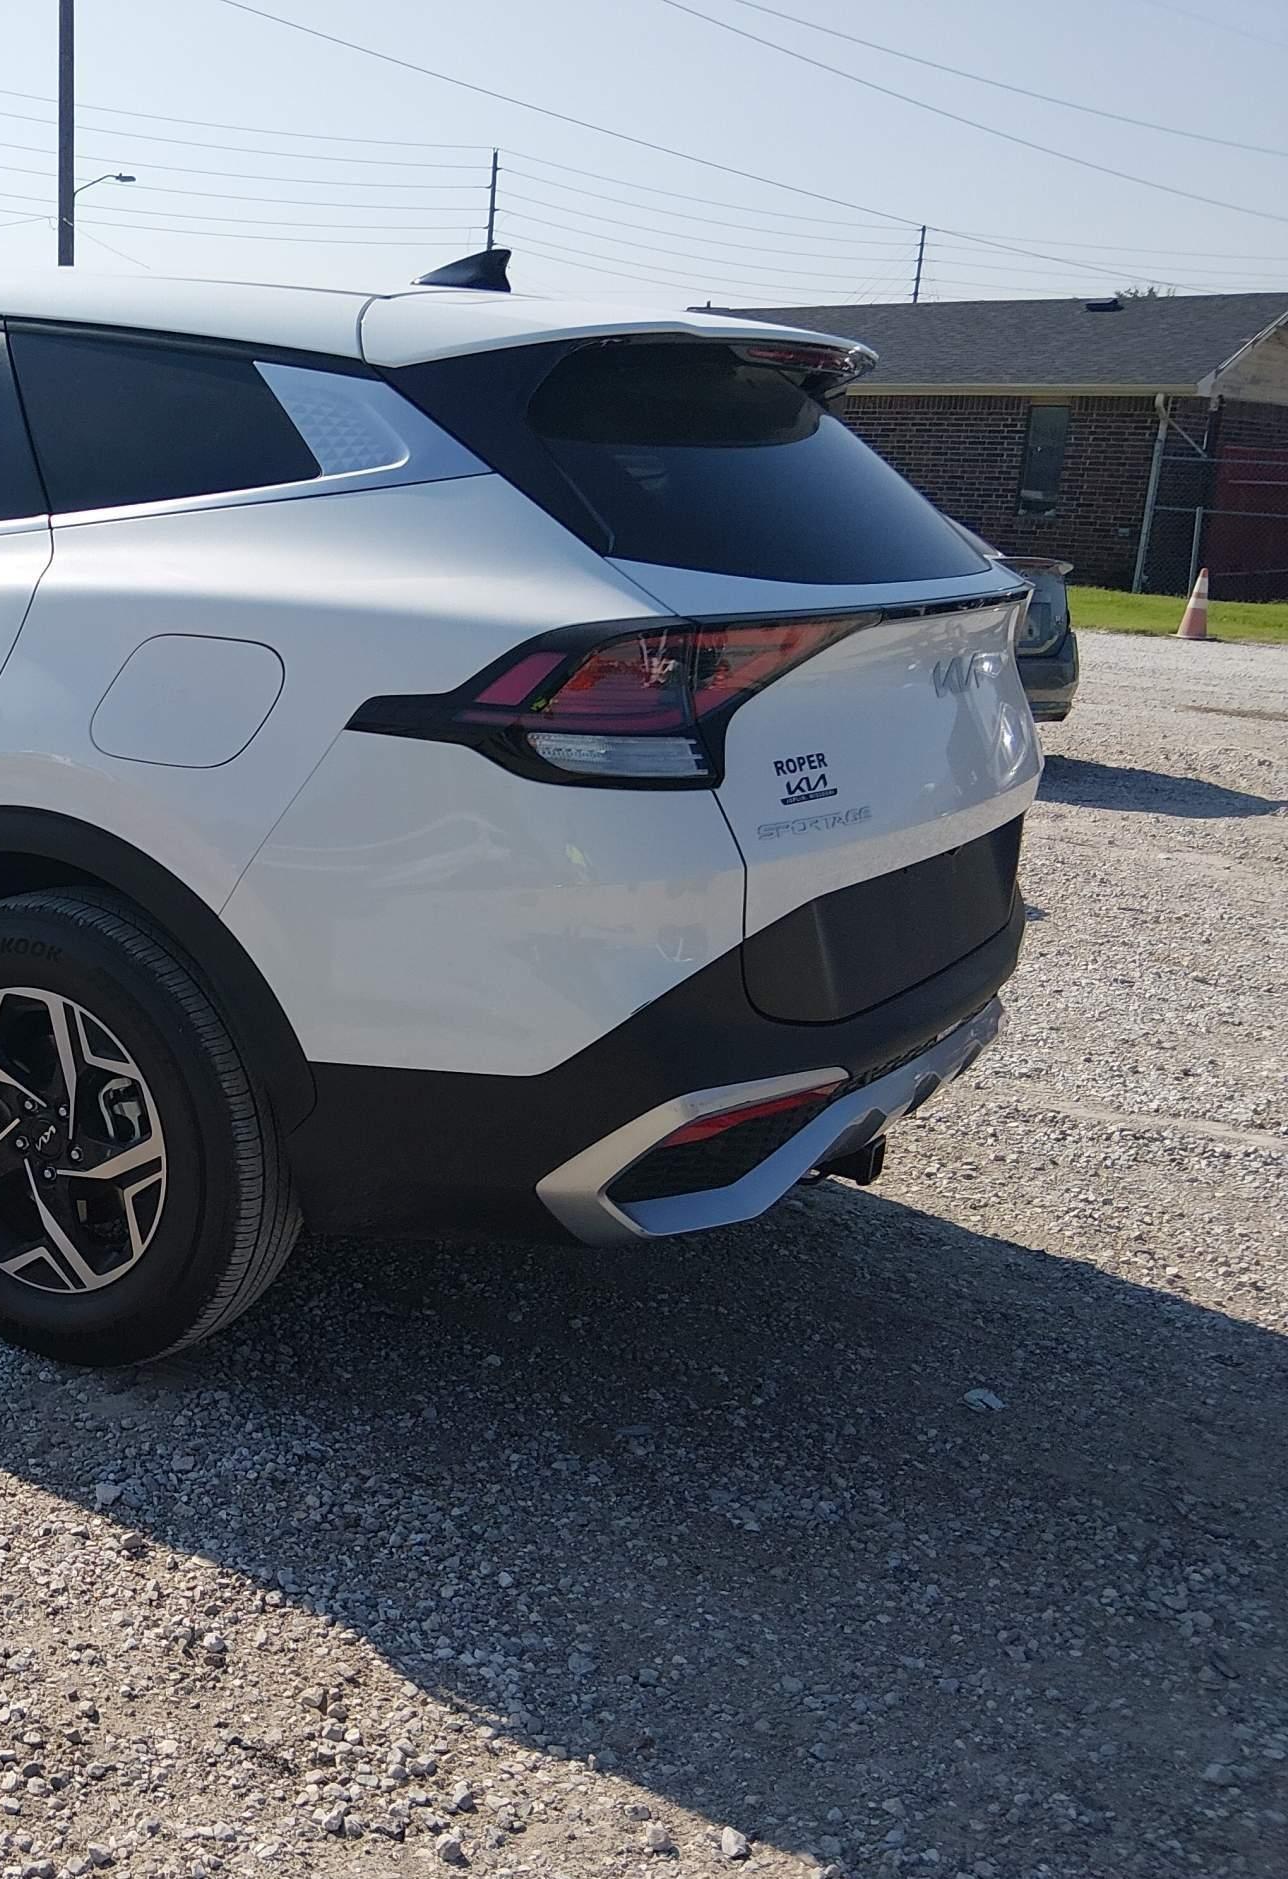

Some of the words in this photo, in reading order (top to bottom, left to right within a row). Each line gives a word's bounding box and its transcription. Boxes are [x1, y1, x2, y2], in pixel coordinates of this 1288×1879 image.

[773, 753, 828, 776] ROPER
[786, 773, 828, 795] KIA
[757, 806, 872, 840] SPORTAGE
